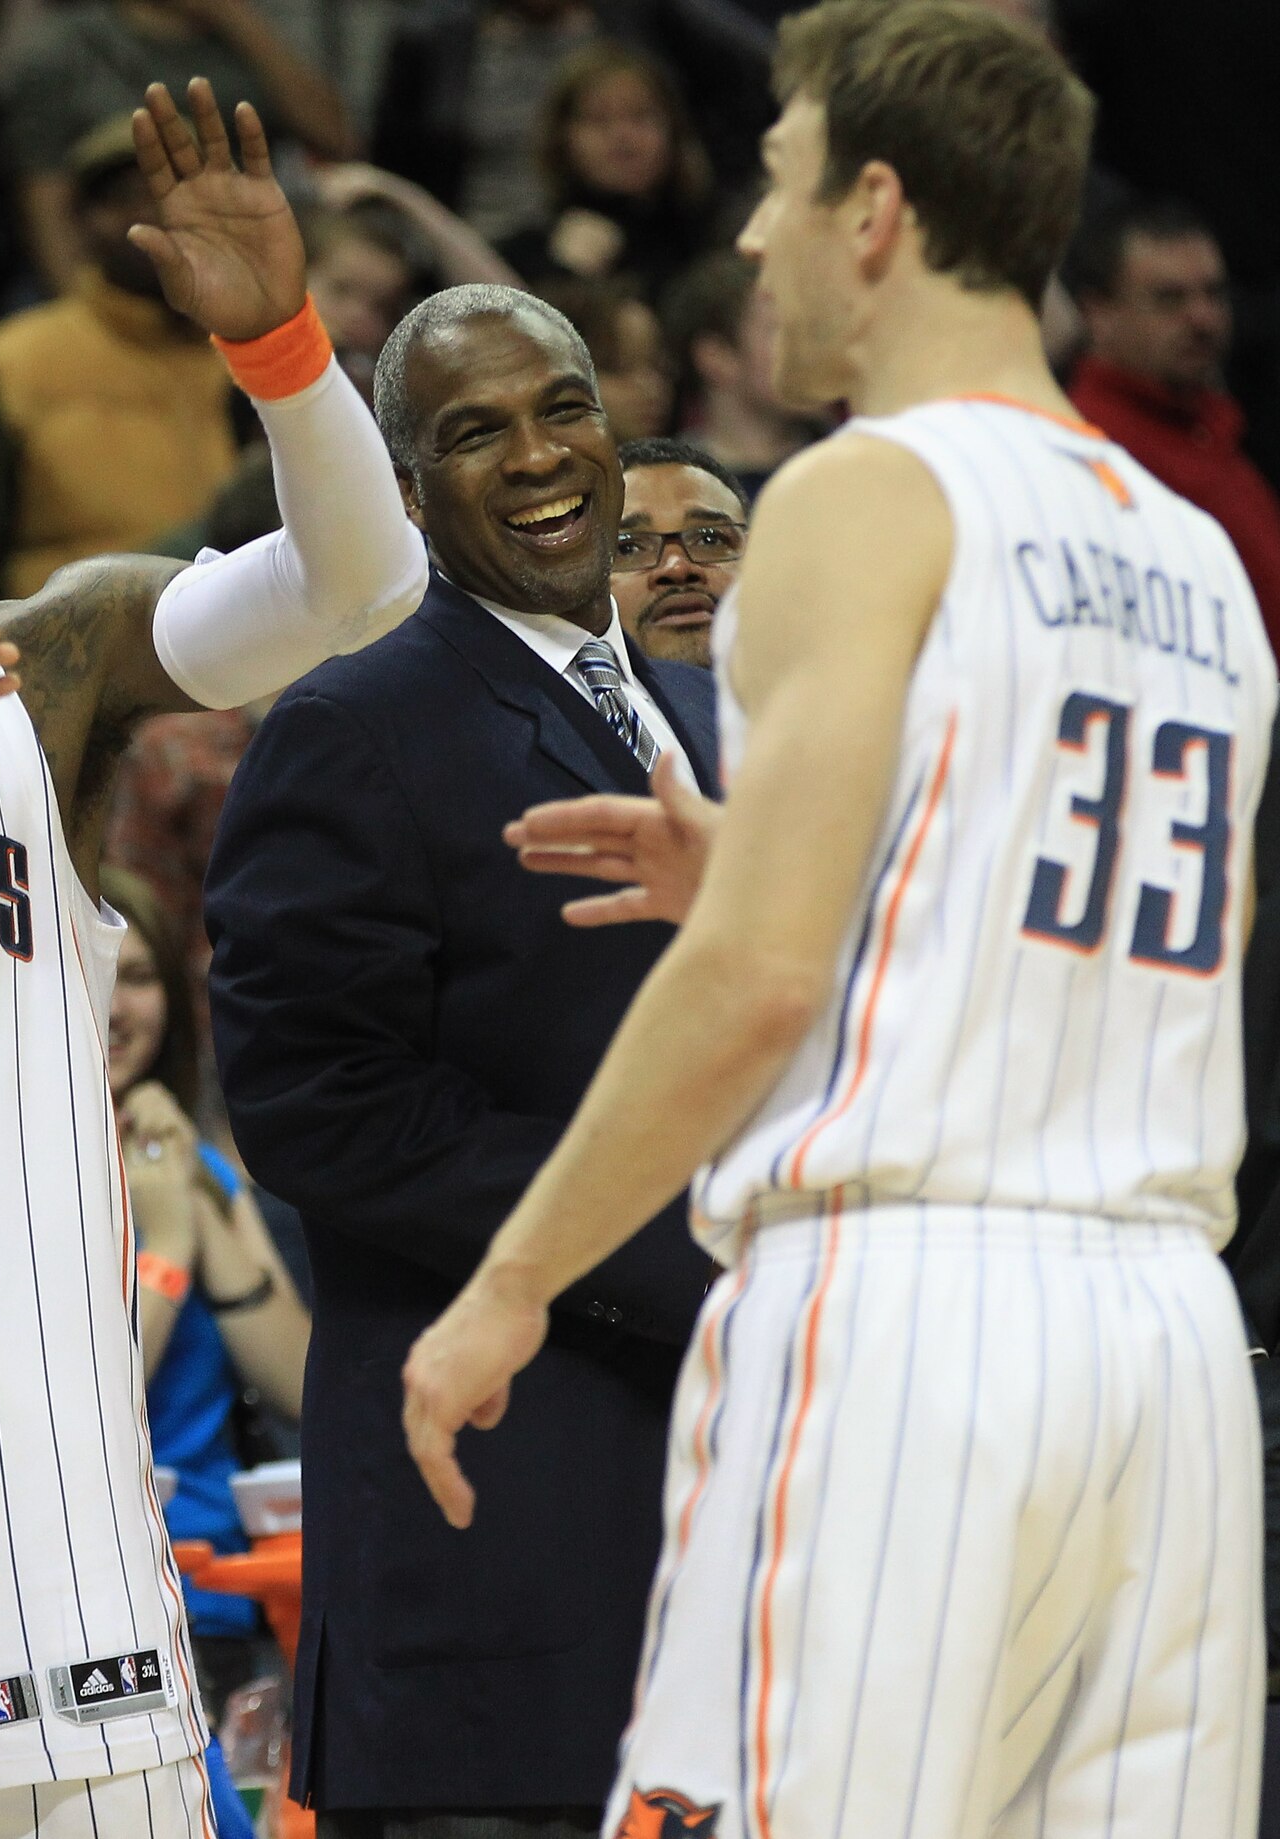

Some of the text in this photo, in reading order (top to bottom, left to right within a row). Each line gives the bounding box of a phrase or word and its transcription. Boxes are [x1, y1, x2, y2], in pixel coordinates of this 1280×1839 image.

[1019, 689, 1235, 980] 33
[141, 1663, 159, 1679] 3XL
[79, 1683, 115, 1698] adidas
